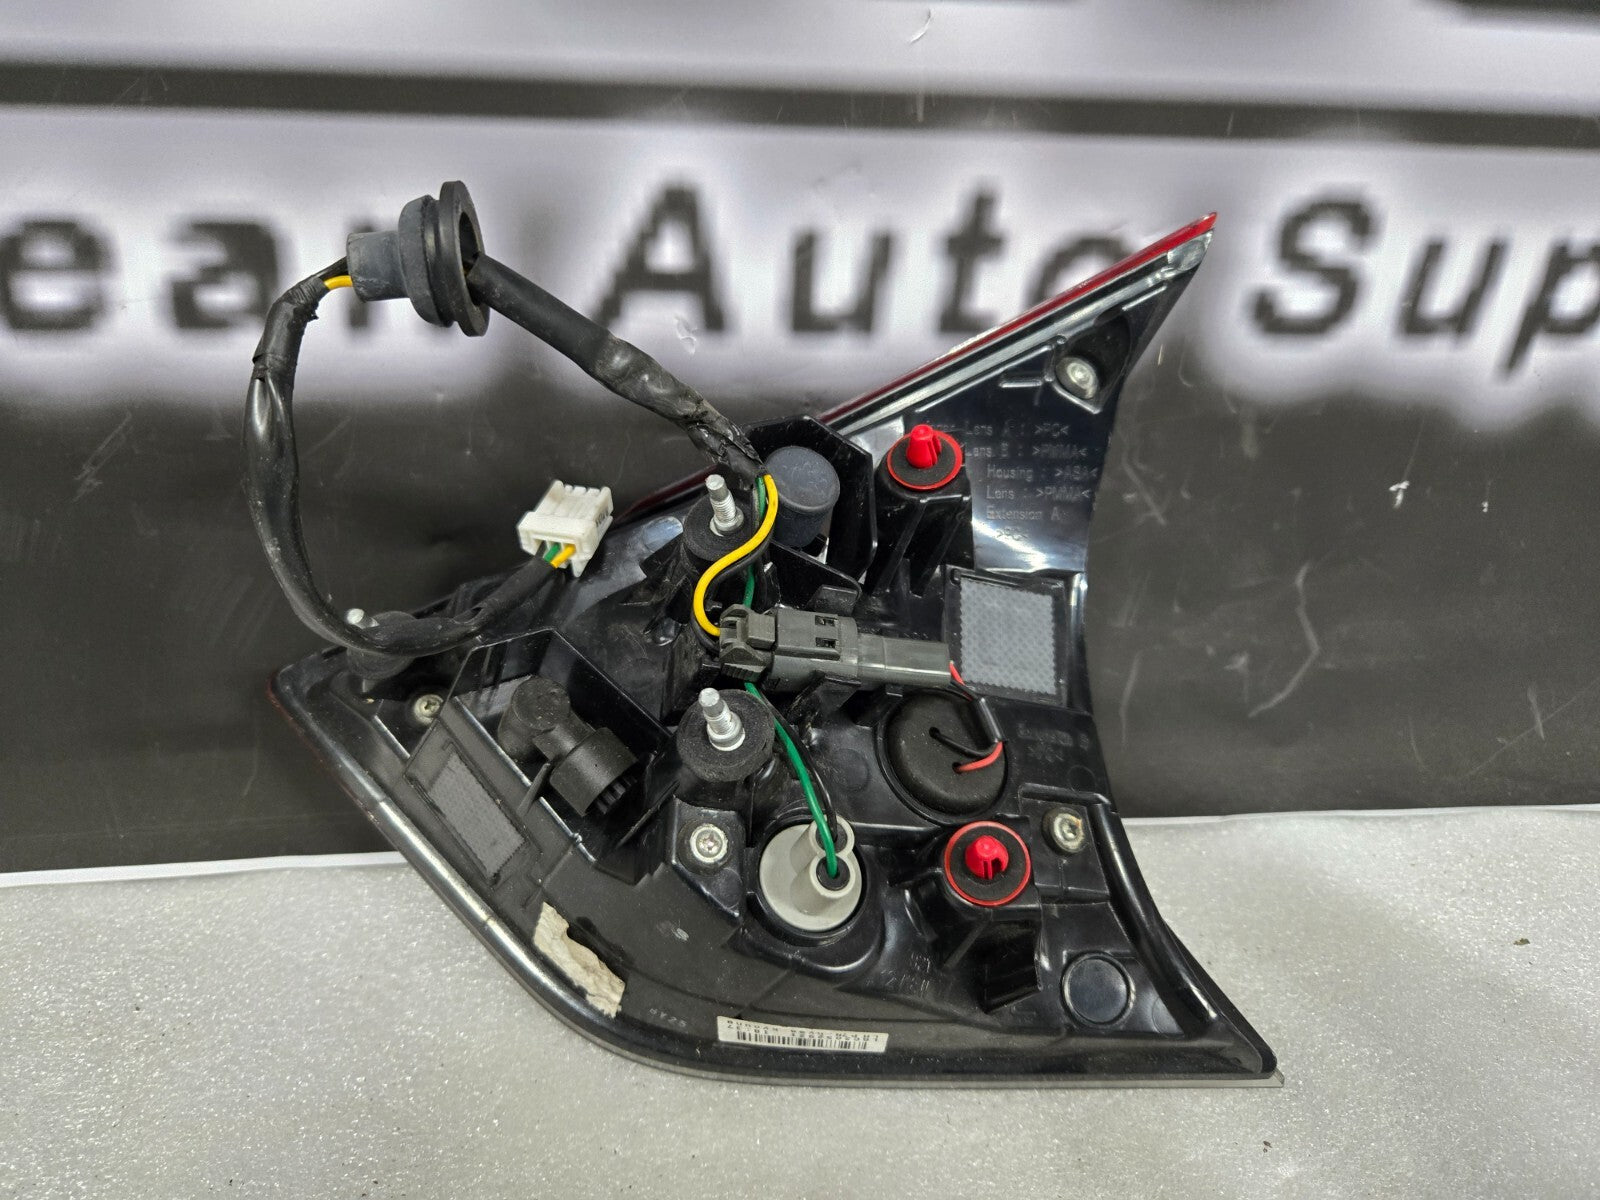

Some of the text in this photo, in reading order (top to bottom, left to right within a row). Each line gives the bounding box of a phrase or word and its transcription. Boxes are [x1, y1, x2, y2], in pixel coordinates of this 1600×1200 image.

[987, 464, 1034, 482] Housing
[986, 485, 1015, 501] Lens
[986, 505, 1043, 521] Extension
